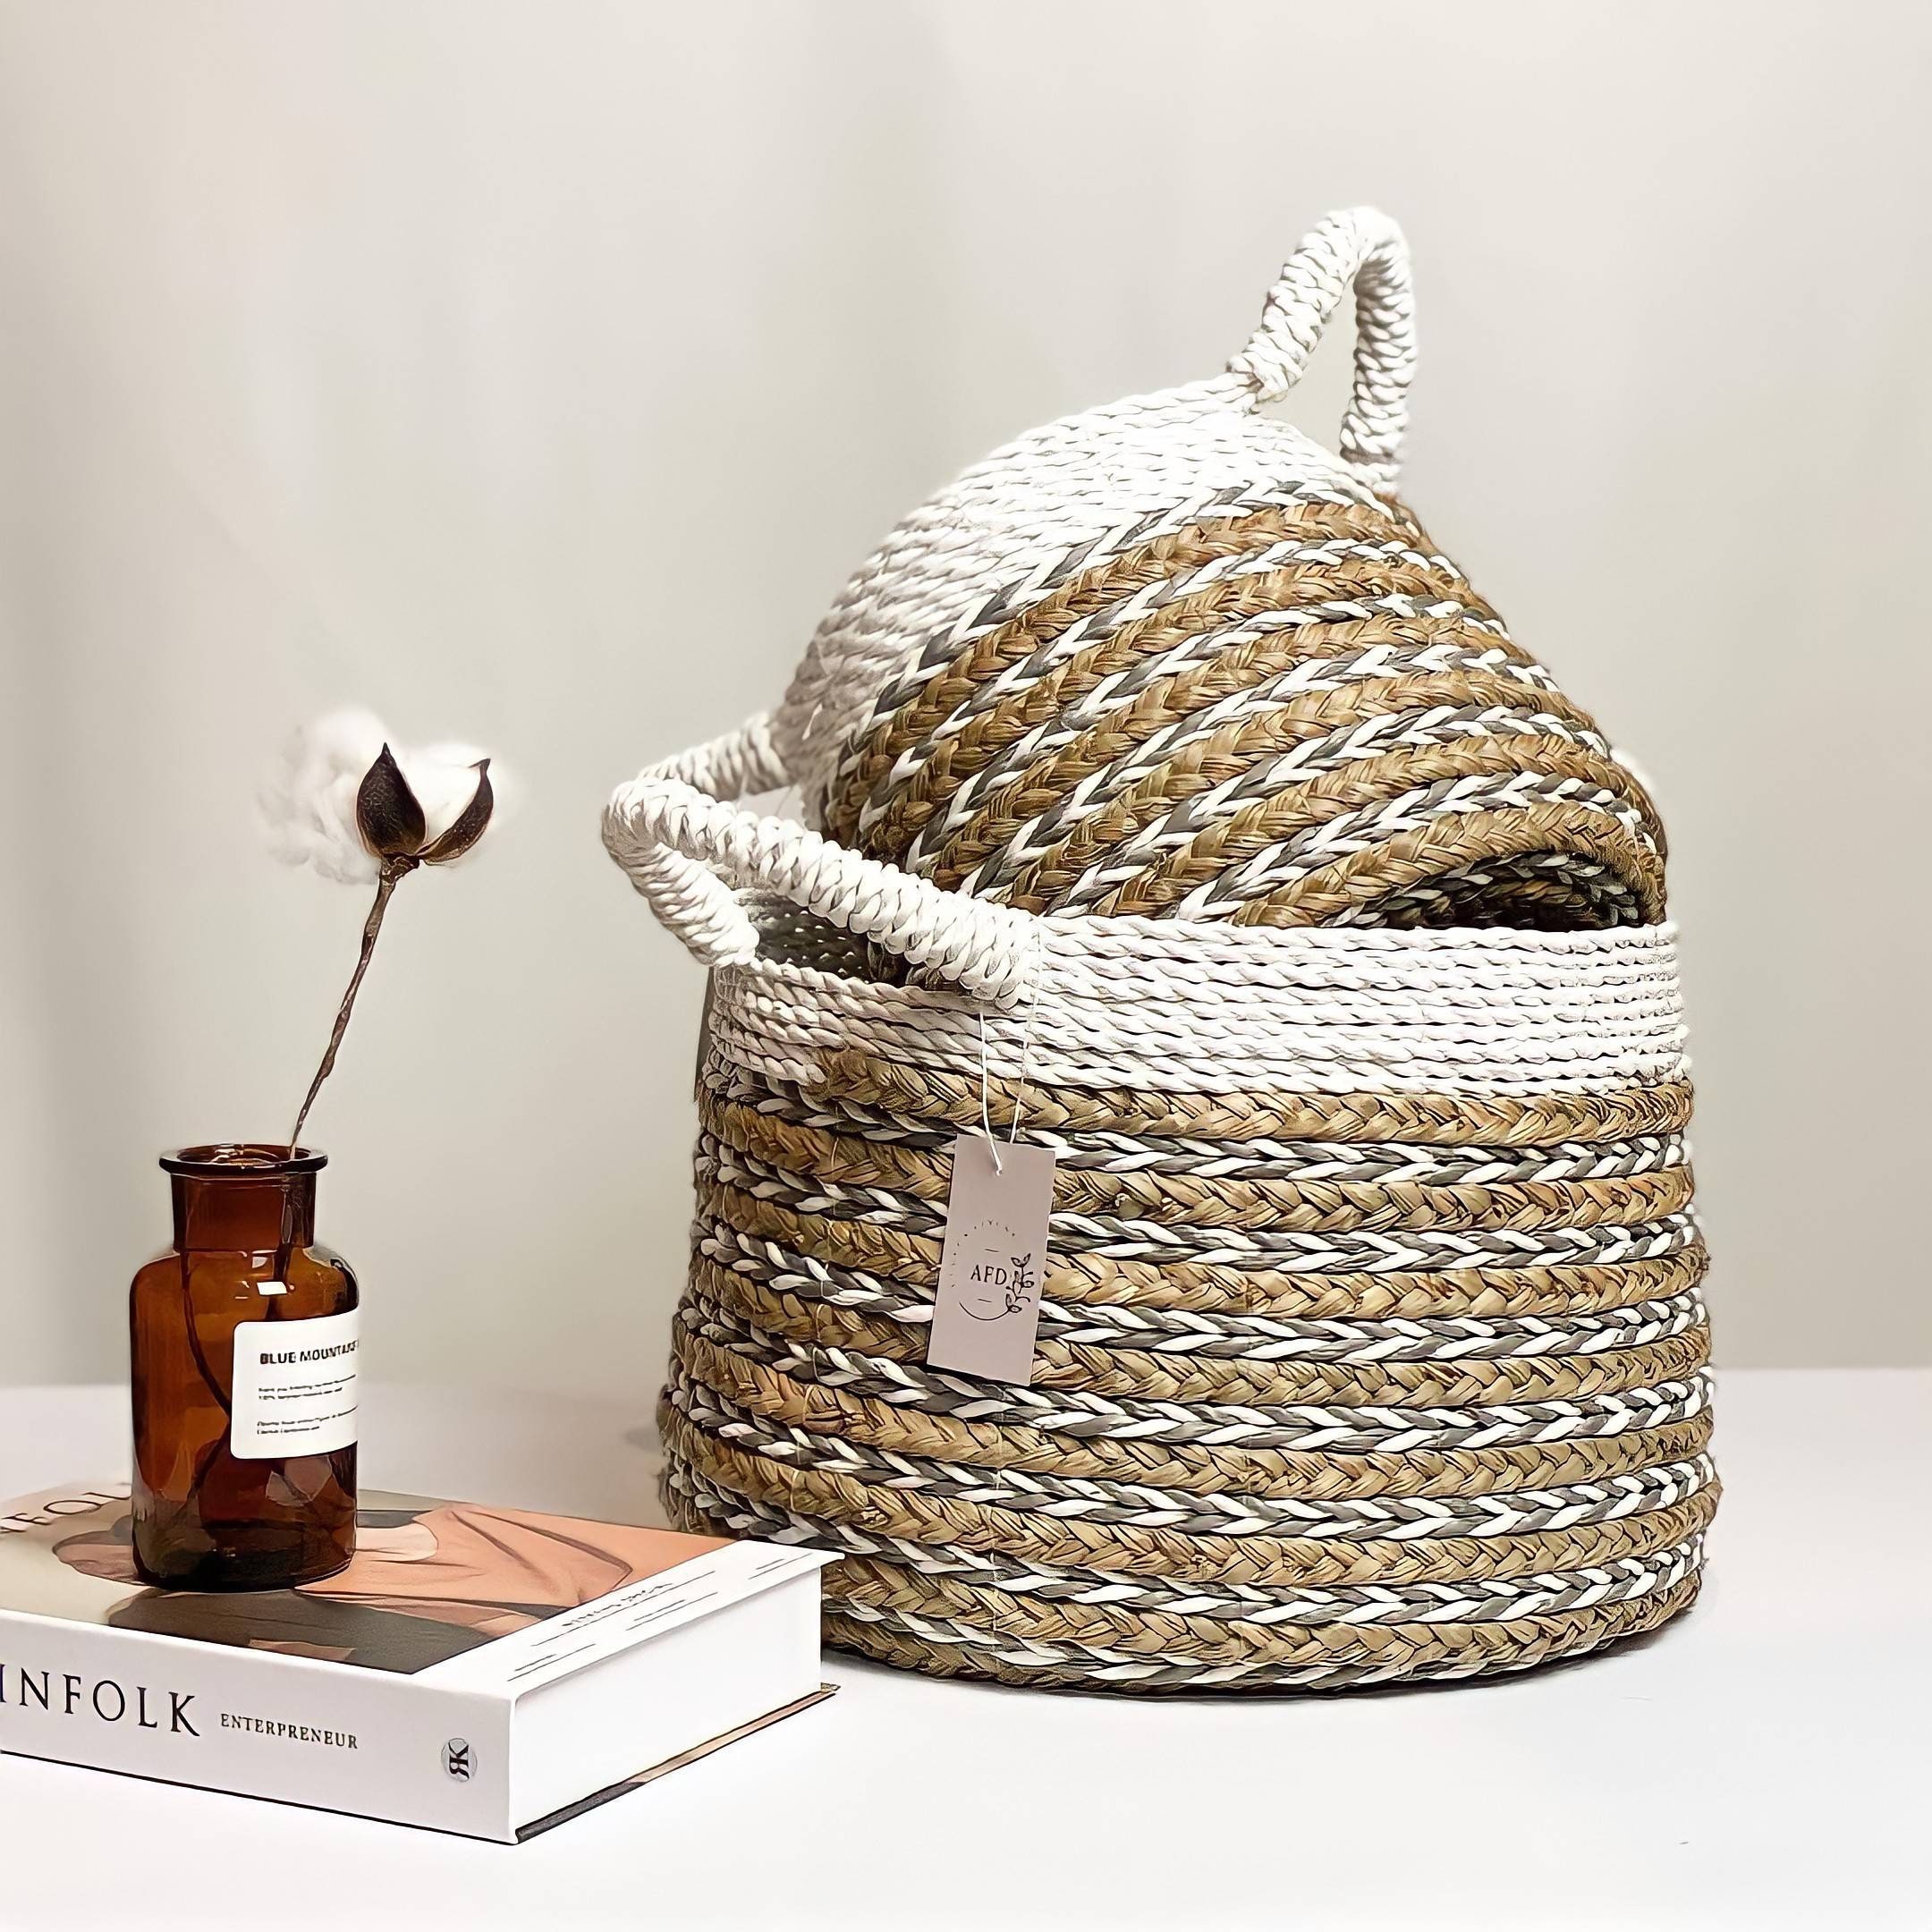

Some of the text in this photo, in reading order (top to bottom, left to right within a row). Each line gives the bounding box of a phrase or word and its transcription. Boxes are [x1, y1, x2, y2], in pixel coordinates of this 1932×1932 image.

[970, 1264, 1007, 1285] AFD
[259, 1352, 297, 1365] BLUE
[220, 1713, 359, 1750] ENTERPRENEUR
